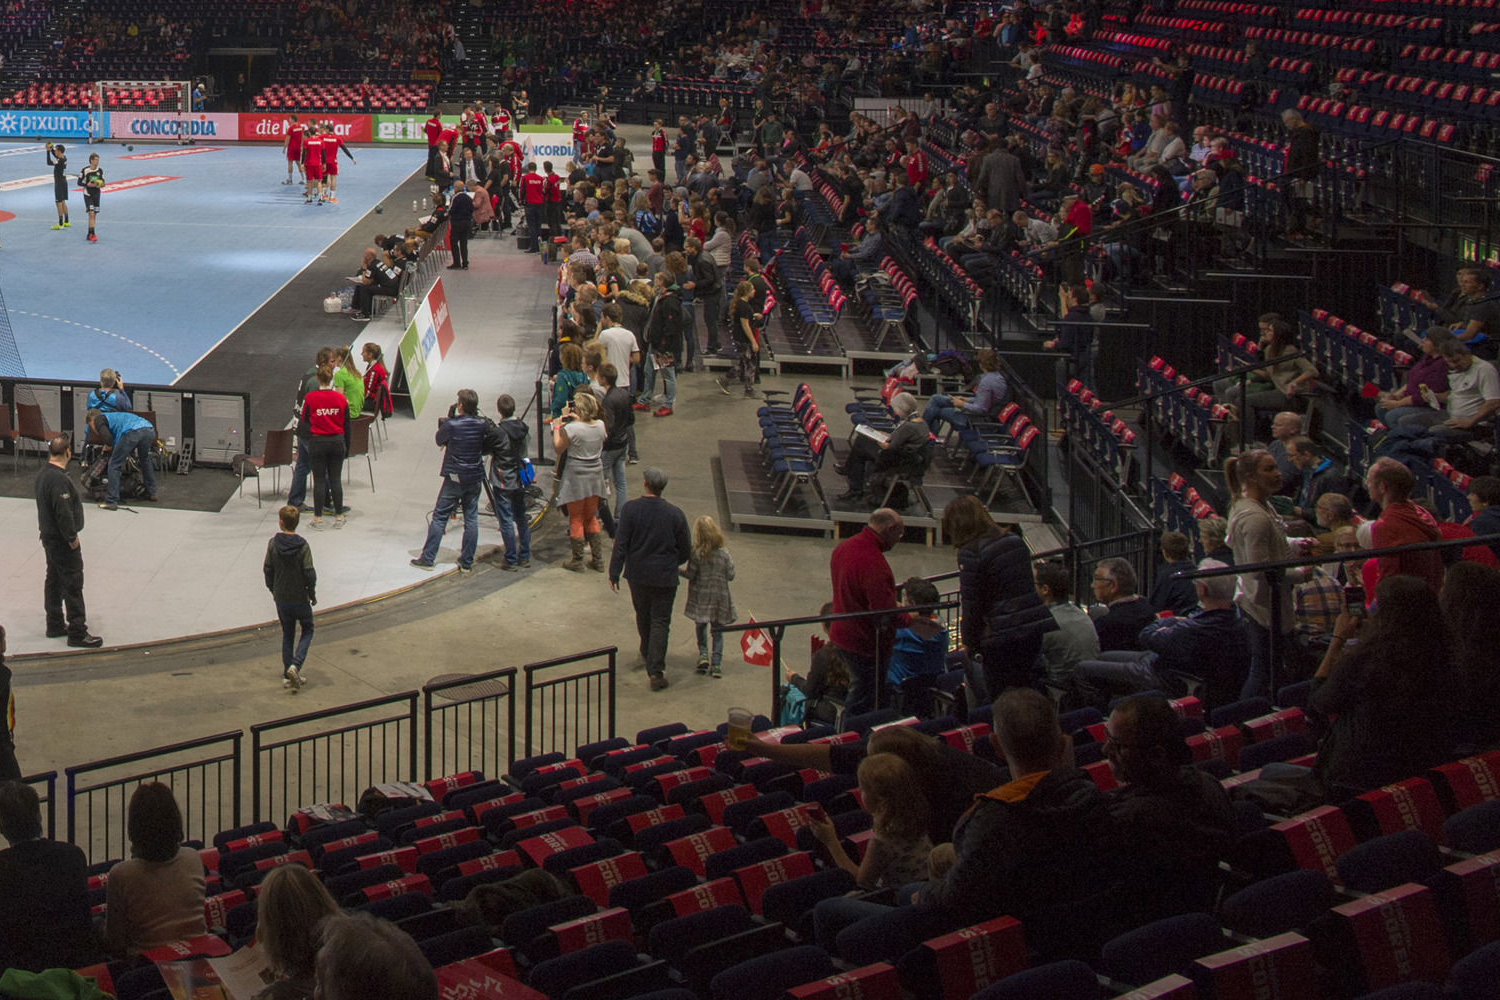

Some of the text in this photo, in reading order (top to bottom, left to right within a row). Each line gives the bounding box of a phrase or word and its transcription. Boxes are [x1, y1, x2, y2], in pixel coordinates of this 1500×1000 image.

[20, 115, 99, 135] pixum.ch
[131, 114, 216, 135] CONCORDIA
[256, 119, 280, 135] die
[520, 141, 576, 156] NCORDI
[317, 408, 340, 416] STAFF
